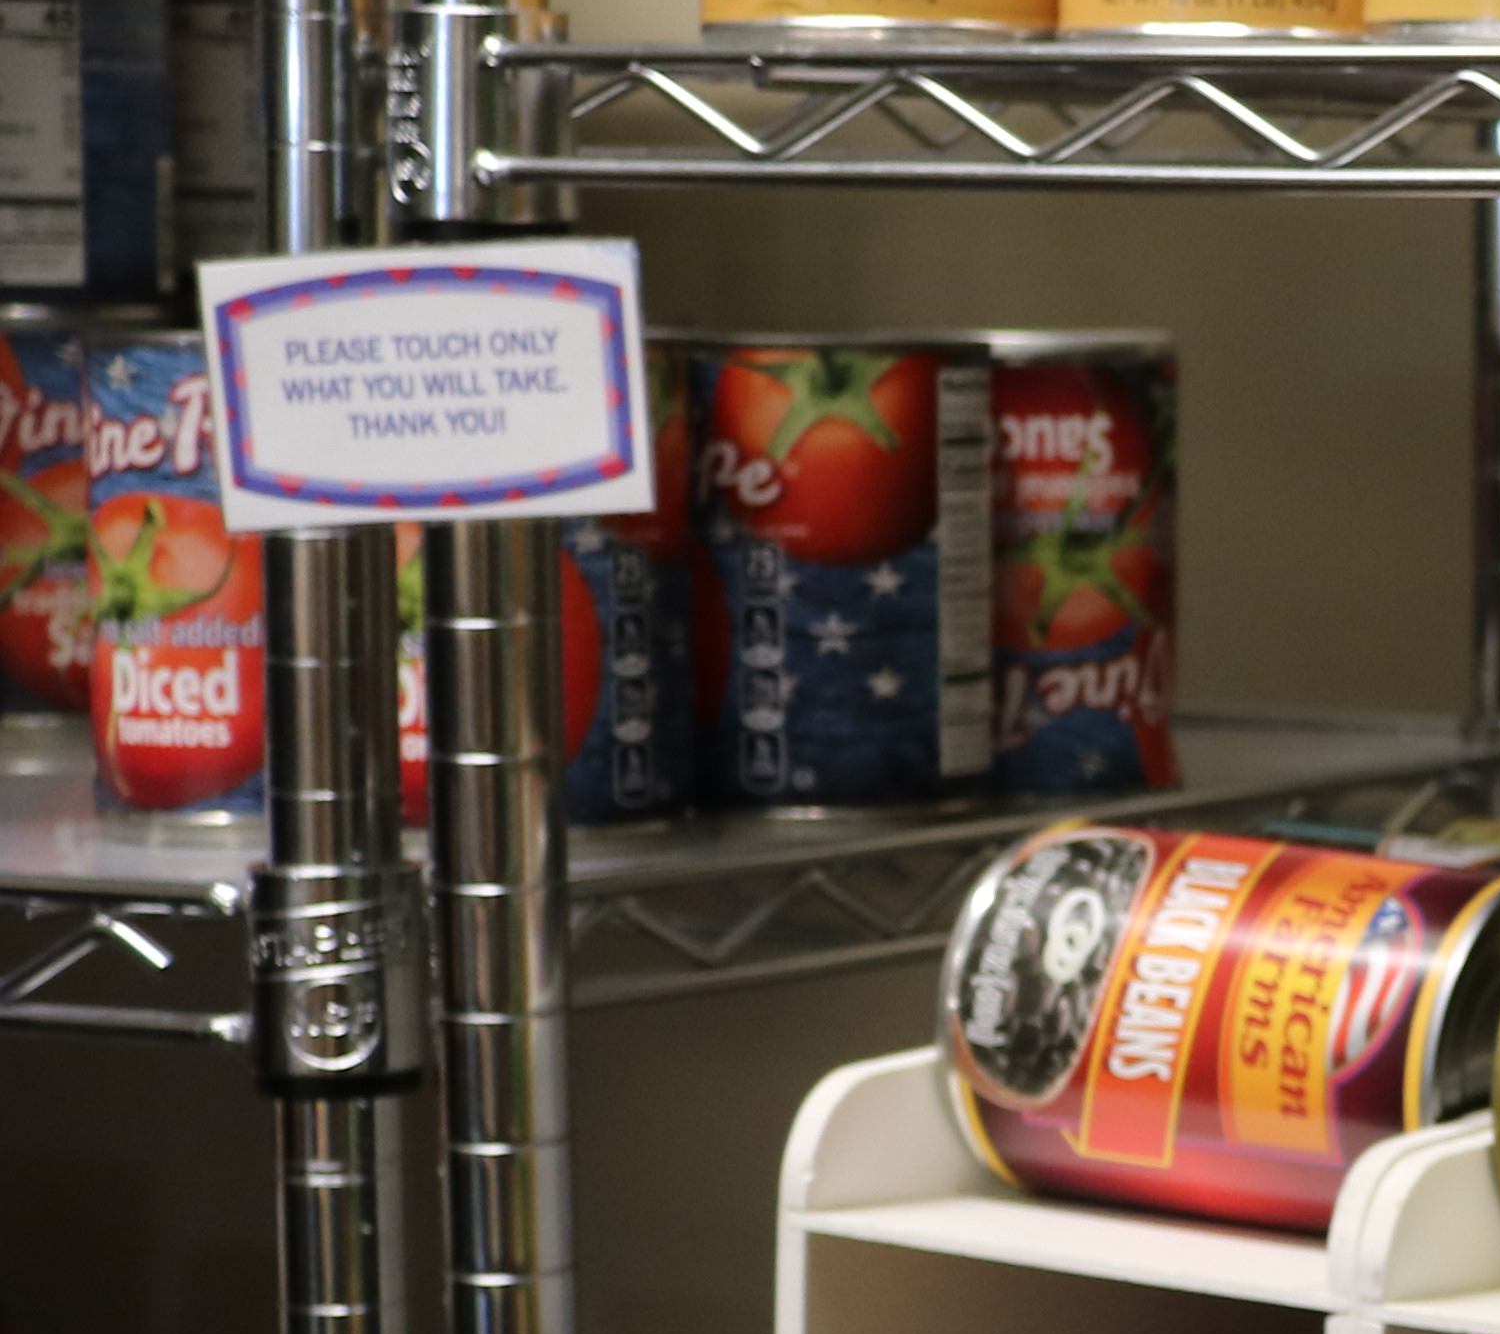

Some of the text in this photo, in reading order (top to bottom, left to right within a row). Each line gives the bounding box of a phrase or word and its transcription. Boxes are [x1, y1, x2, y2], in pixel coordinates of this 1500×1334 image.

[284, 328, 559, 364] PLEASE TOUCH ONLY
[281, 368, 567, 403] WHAT YOU WILL TAKE.
[348, 409, 507, 440] THANK YOU!
[115, 652, 240, 715] Diced
[1108, 857, 1250, 1082] BLACK BEANS
[1239, 894, 1320, 1068] Farms
[1277, 871, 1387, 1120] American
